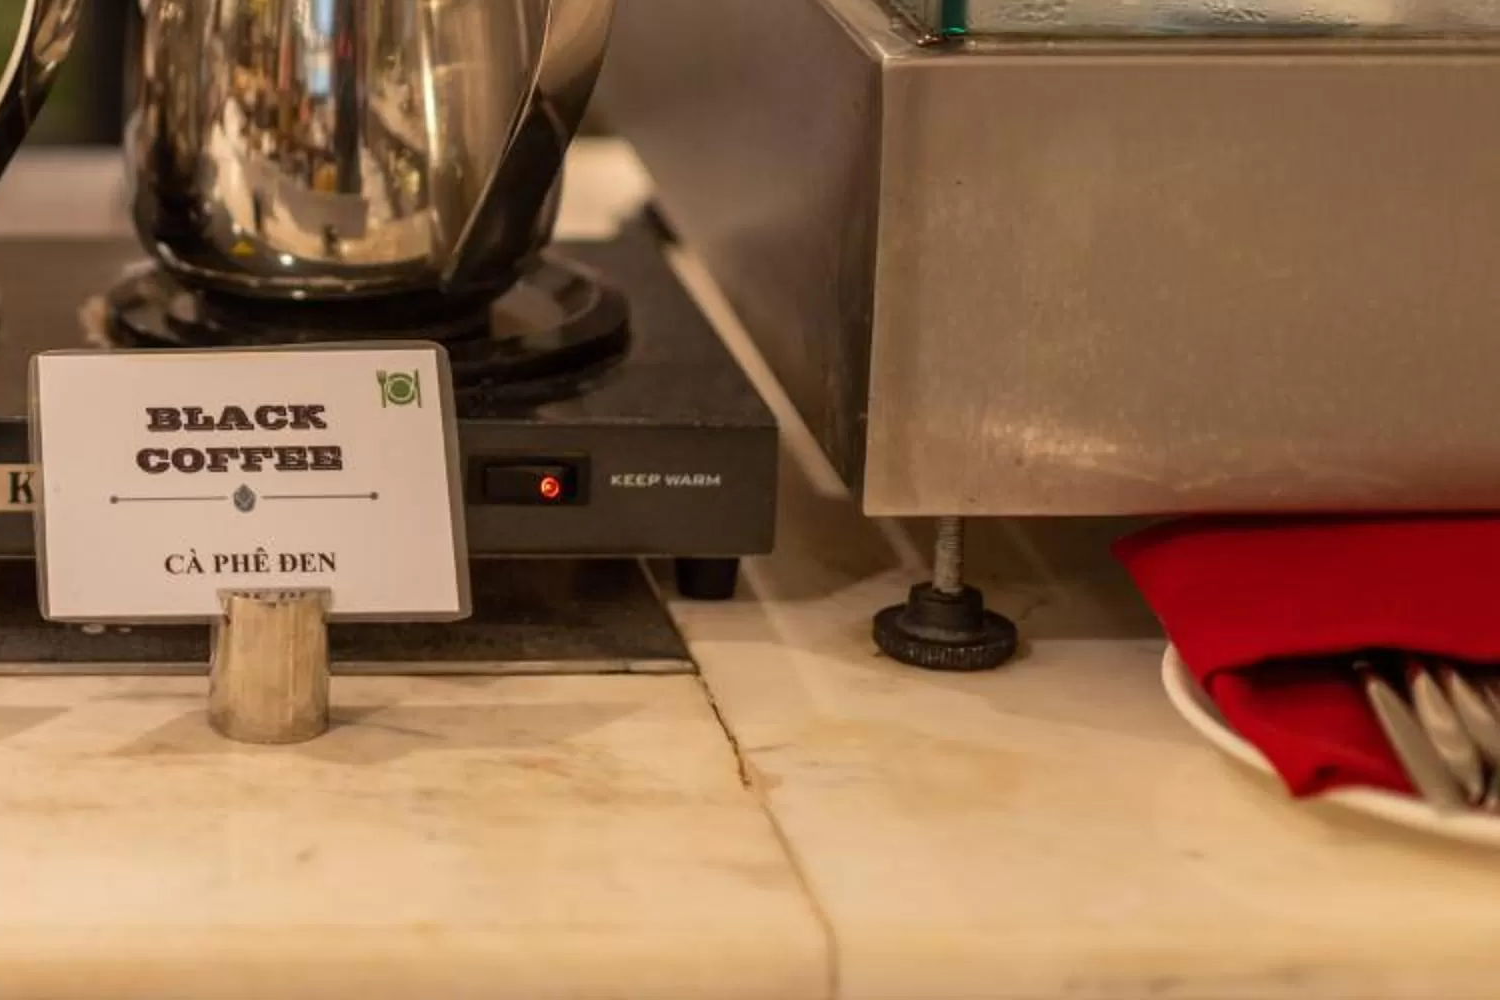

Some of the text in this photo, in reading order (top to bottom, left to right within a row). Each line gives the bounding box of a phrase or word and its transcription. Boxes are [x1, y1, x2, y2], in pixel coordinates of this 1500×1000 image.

[145, 404, 328, 433] BLACK
[135, 445, 343, 474] COFFEE
[611, 473, 721, 487] KEEP WARM
[164, 547, 336, 575] CÀ PHÊ ĐEN
